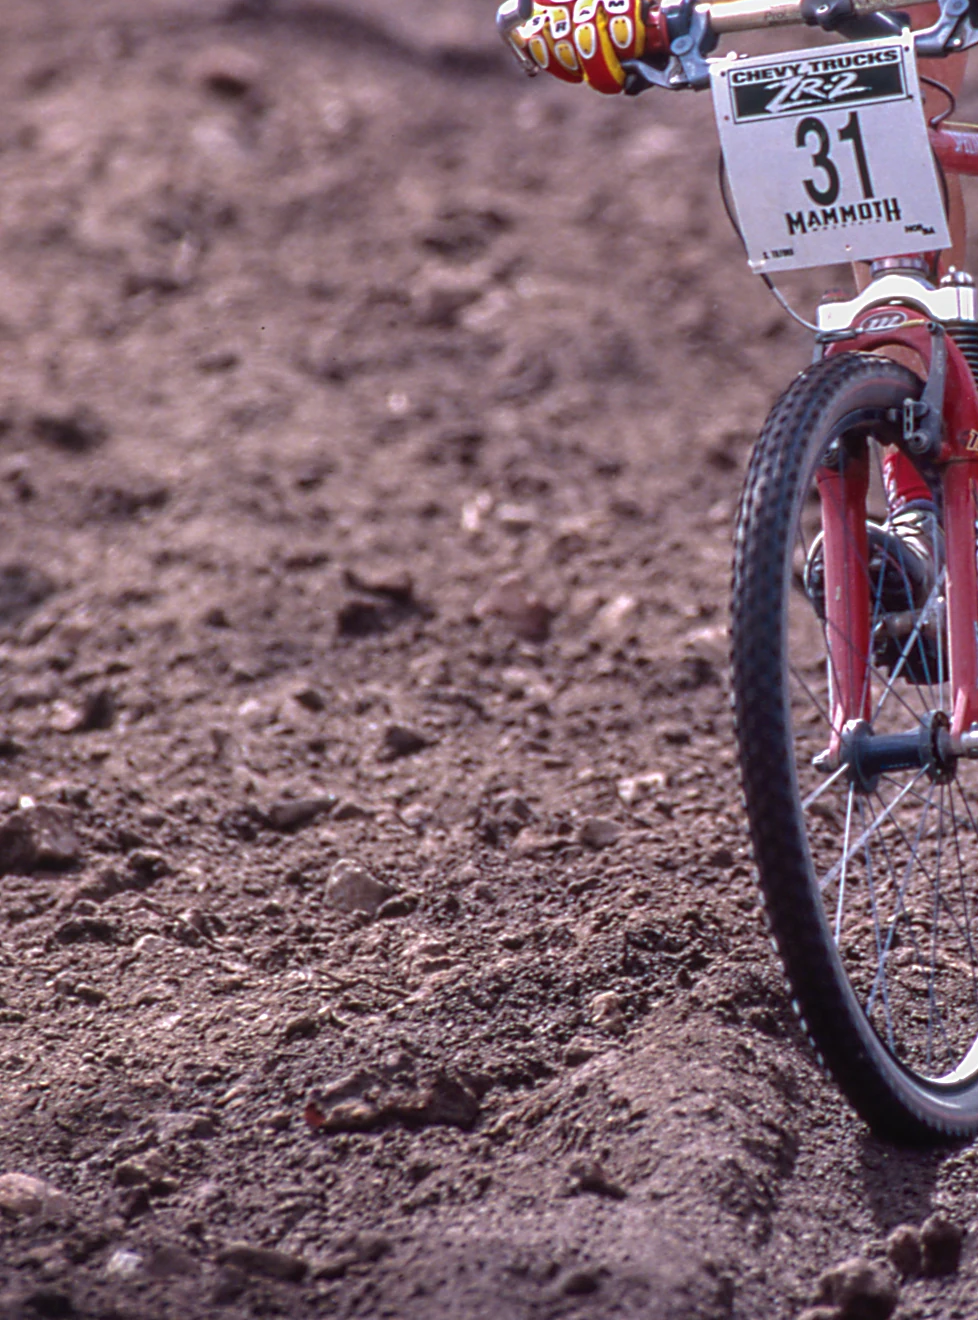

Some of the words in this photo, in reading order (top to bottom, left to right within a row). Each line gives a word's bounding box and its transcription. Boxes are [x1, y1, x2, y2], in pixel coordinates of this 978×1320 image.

[731, 60, 804, 84] CHEVY
[809, 49, 899, 73] TRUCKS
[796, 111, 874, 206] 31
[785, 197, 901, 235] MAMMOTH
